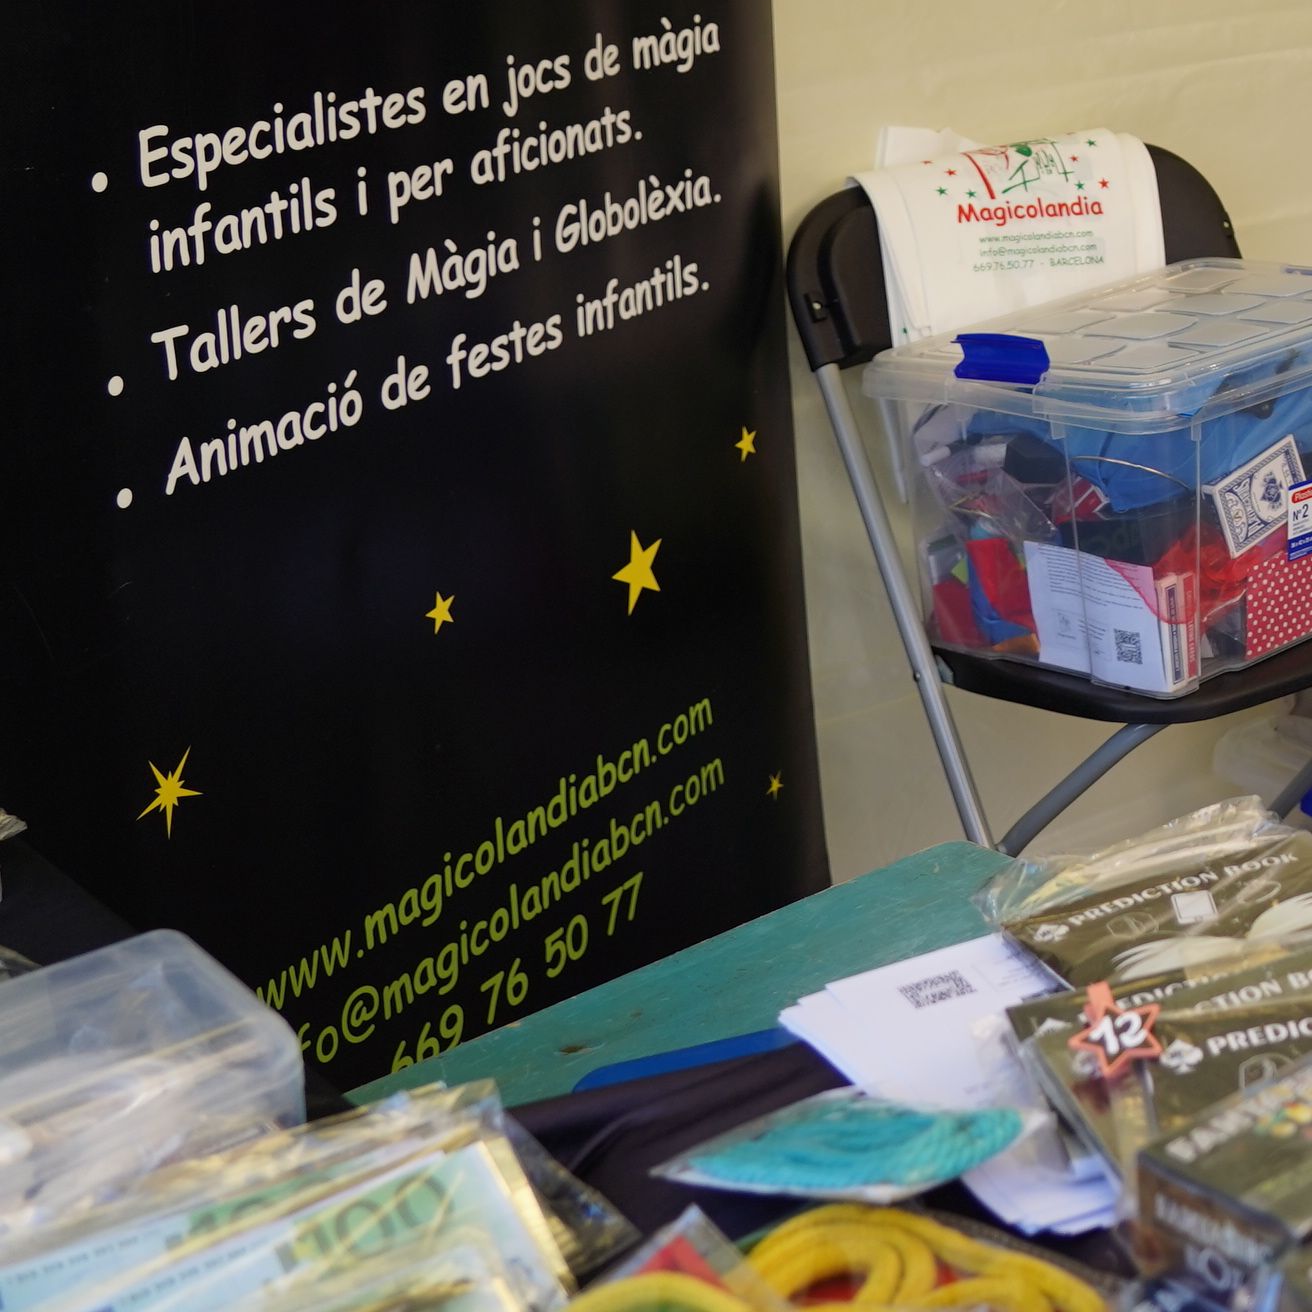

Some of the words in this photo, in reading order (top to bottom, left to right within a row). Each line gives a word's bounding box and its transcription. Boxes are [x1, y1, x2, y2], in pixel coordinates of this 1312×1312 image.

[138, 87, 427, 191] Especialistes
[442, 73, 489, 114] en
[502, 54, 572, 118] jocs
[584, 32, 621, 81] de
[632, 13, 720, 74] màgia
[149, 176, 338, 274] infantils
[357, 166, 367, 216] i
[387, 157, 454, 225] per
[470, 106, 643, 185] aficionats.
[957, 195, 1104, 227] Magicolandia
[979, 230, 1094, 244] www.magicolandiabcn.com
[150, 298, 317, 382] Tallers
[335, 267, 388, 325] de
[406, 230, 520, 304] Màgia
[532, 216, 542, 262] i
[555, 168, 722, 253] Globolèxia.
[1049, 255, 1105, 268] BARCELONA
[165, 369, 363, 495] Animació
[381, 354, 431, 410] de
[446, 314, 563, 390] festes
[576, 254, 710, 338] infantils.
[1302, 503, 1309, 520] 2
[256, 697, 714, 1013] www.magicolandiabcn.com
[1067, 867, 1219, 928] PREDICTION
[1223, 850, 1299, 880] BOOK
[480, 956, 530, 1026] 76
[544, 912, 589, 979] 50
[600, 870, 644, 936] 77
[1089, 1011, 1147, 1054] 12
